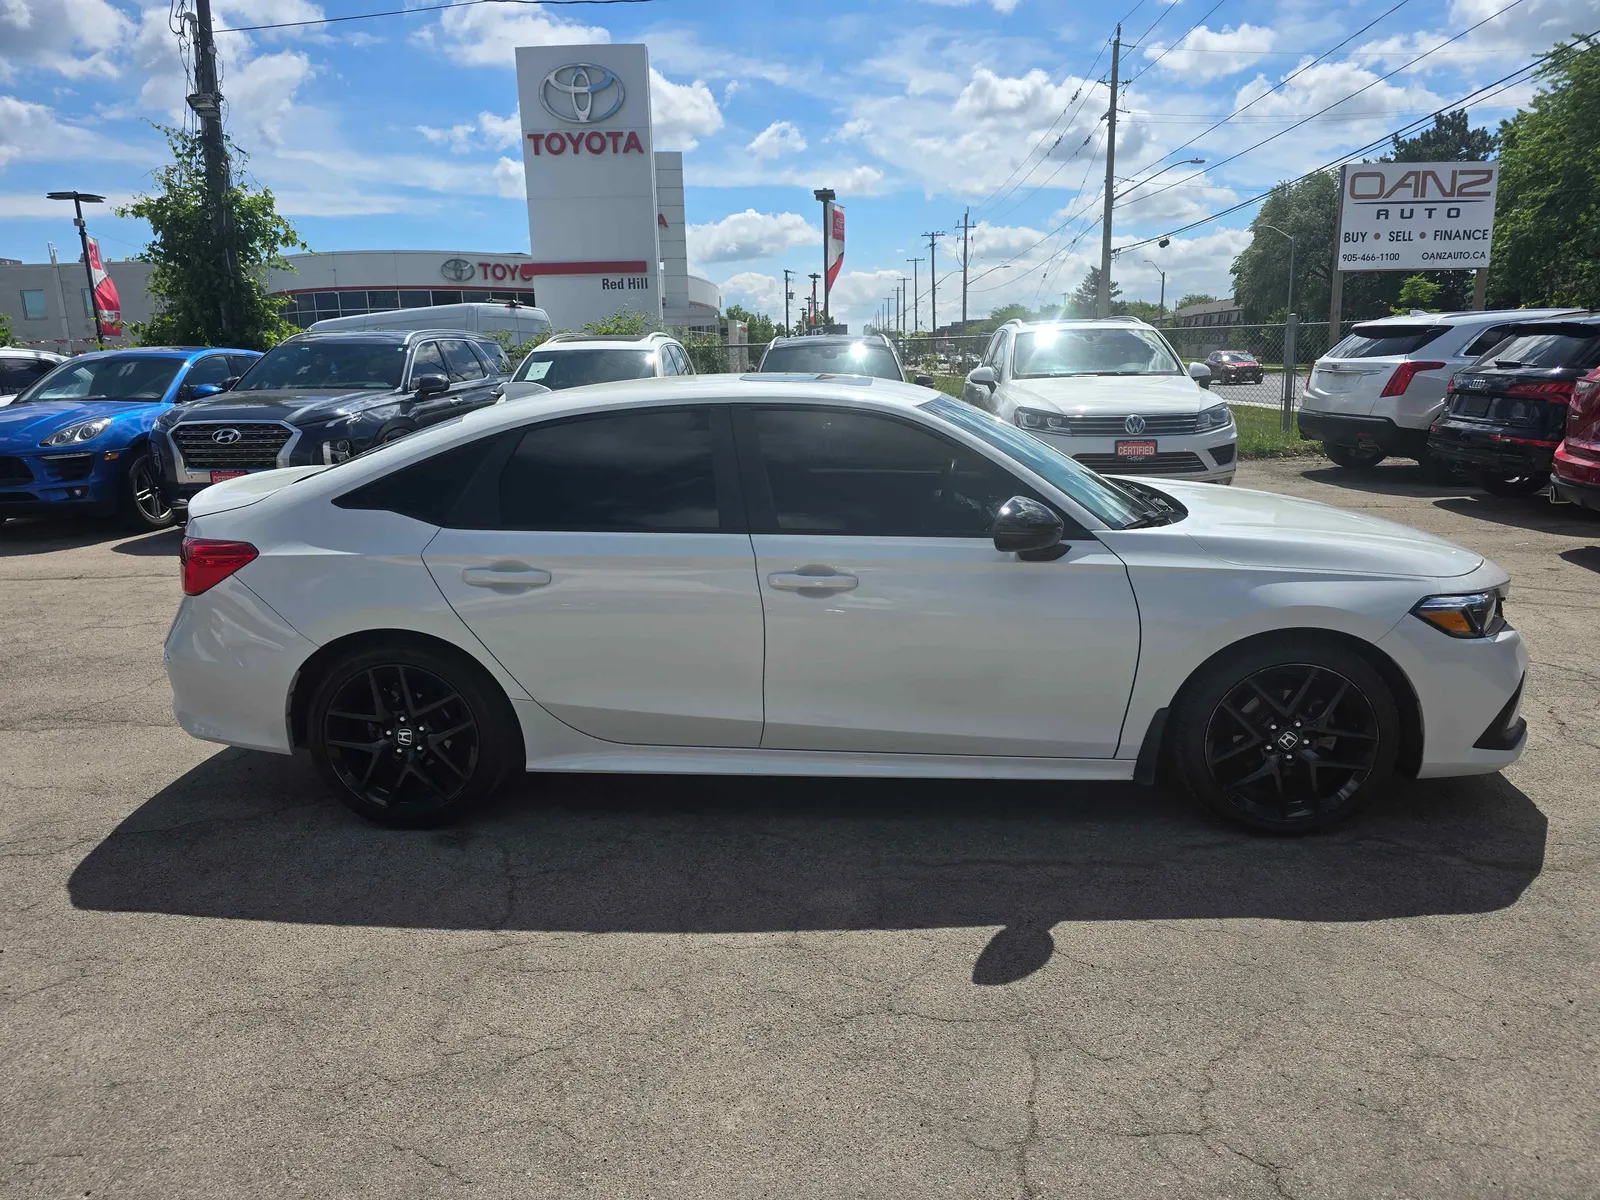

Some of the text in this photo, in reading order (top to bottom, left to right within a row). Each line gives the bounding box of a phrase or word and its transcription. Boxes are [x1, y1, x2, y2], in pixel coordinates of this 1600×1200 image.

[527, 131, 644, 156] TOYOTA
[1350, 169, 1494, 200] OANZ
[1376, 207, 1461, 220] AUTO
[1343, 229, 1489, 243] BUY SELL FINANCE
[1342, 252, 1400, 262] 905-466-1100
[1421, 251, 1486, 260] OANZAUTO.CA
[602, 277, 648, 290] Red Hill
[1117, 446, 1155, 456] CERTIFIED
